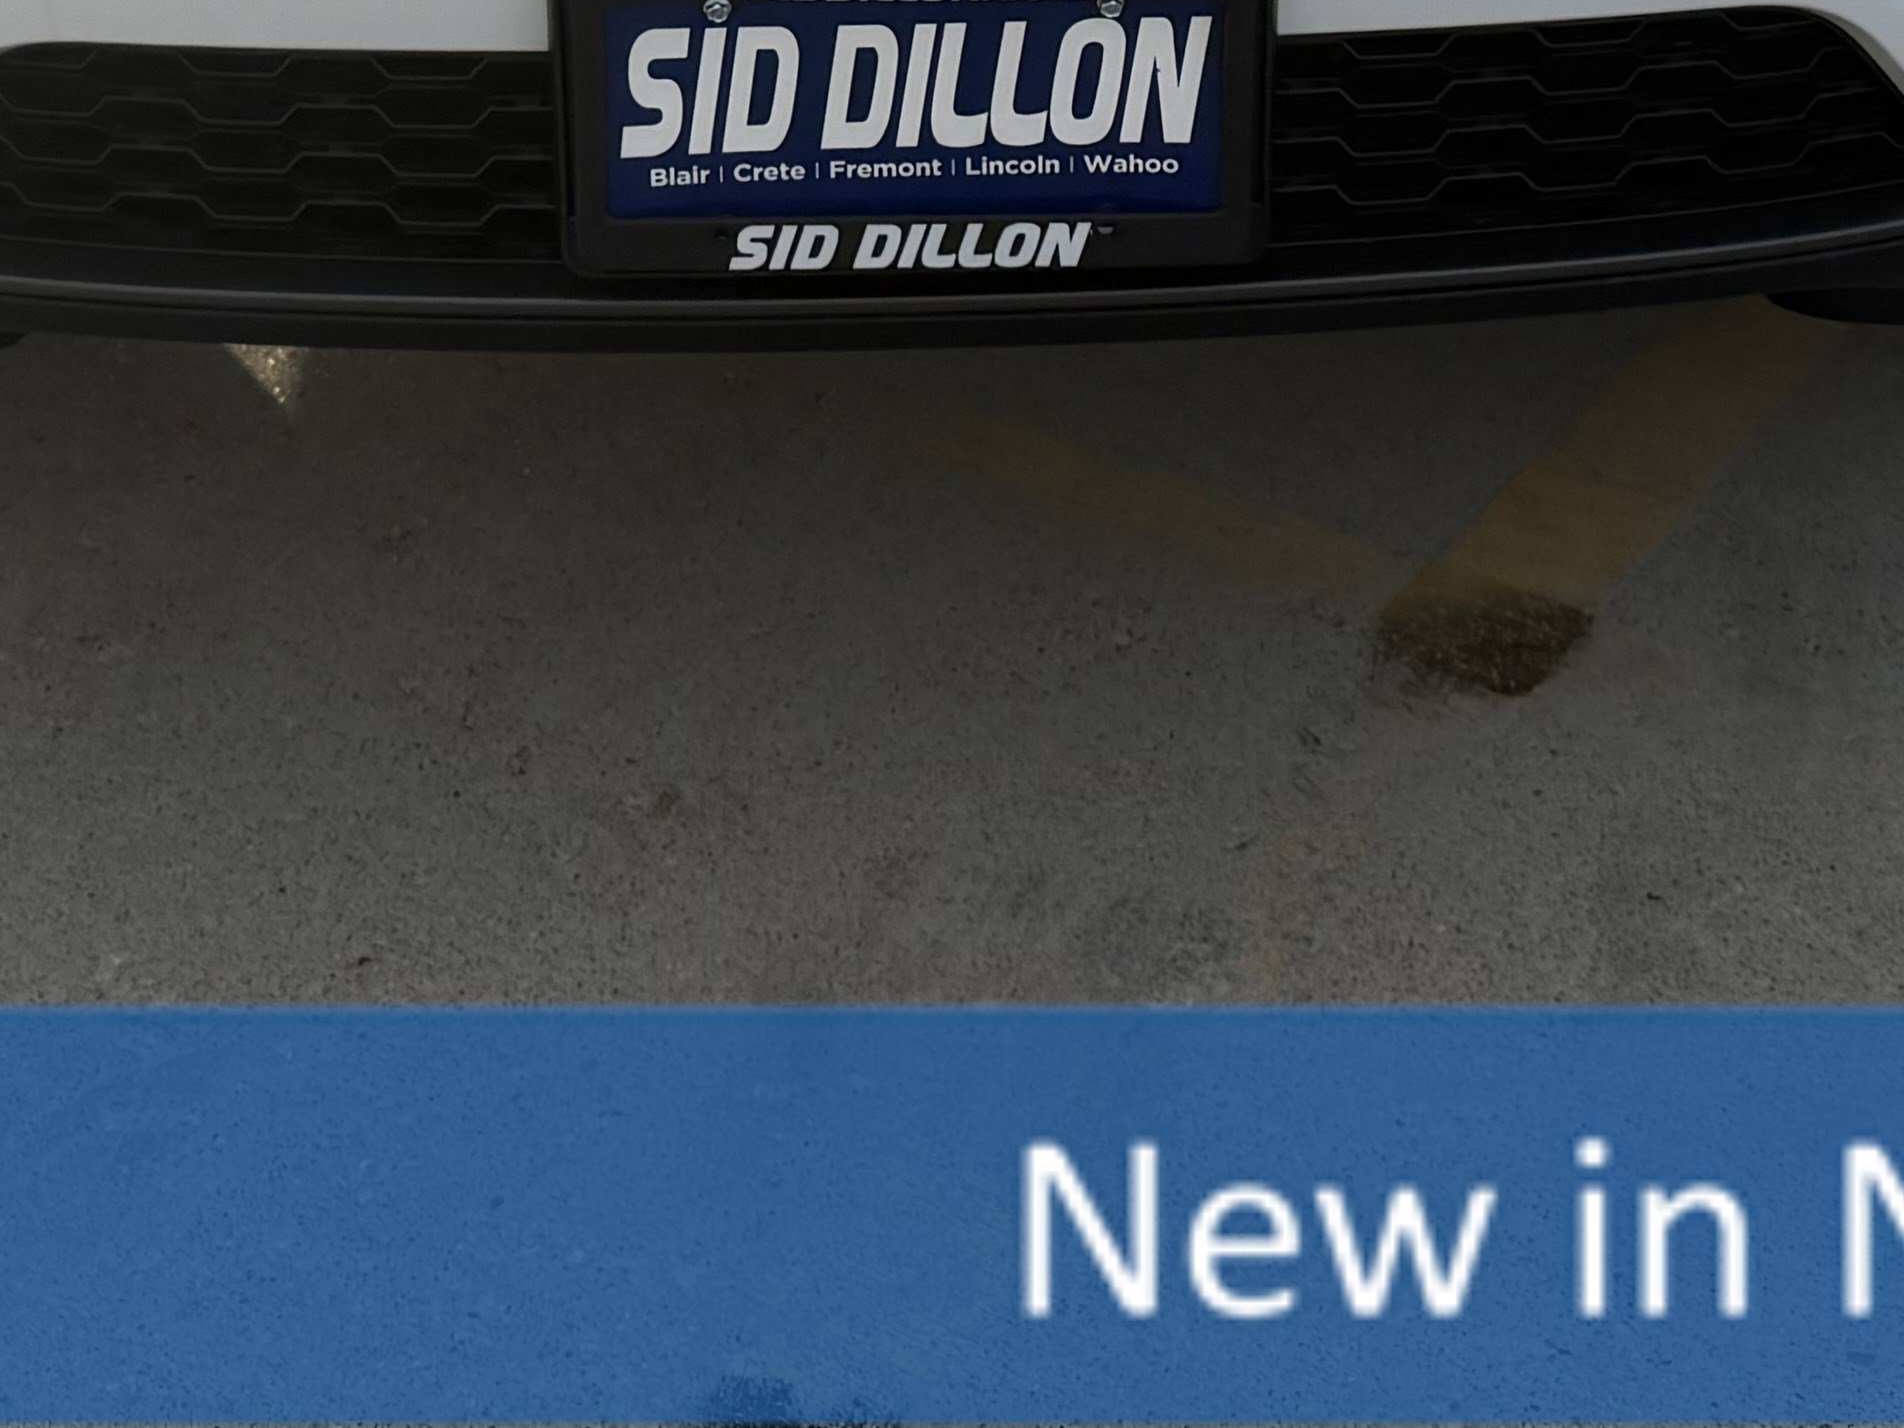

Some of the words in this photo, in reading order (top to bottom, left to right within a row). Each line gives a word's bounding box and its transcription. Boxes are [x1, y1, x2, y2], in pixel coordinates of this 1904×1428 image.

[620, 26, 800, 158] SID
[820, 15, 1213, 150] DILLON
[650, 166, 711, 187] Blair
[733, 163, 806, 182] Crete
[829, 158, 942, 179] Fremont
[965, 155, 1060, 175] Lincoln
[1083, 154, 1179, 174] Wahoo
[728, 224, 839, 271] SID
[852, 222, 1092, 269] DILLON
